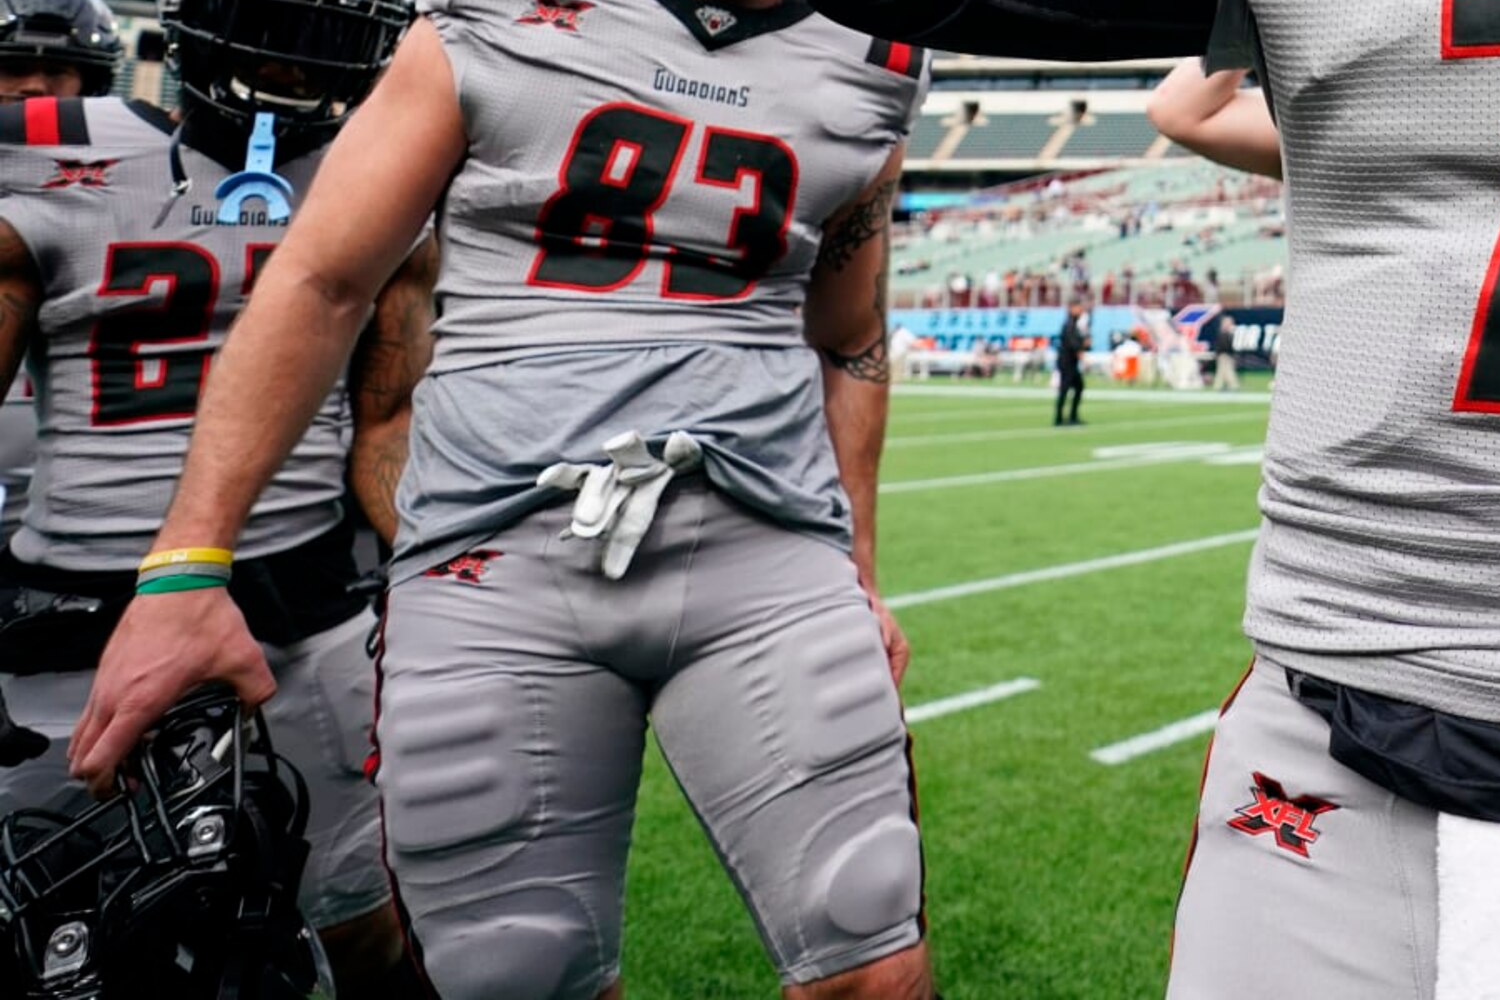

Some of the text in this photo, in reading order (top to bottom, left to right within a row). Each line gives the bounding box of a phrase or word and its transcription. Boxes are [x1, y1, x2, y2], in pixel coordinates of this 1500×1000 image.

[191, 205, 290, 226] GUDIA
[525, 101, 800, 301] 83
[90, 240, 283, 427] 2
